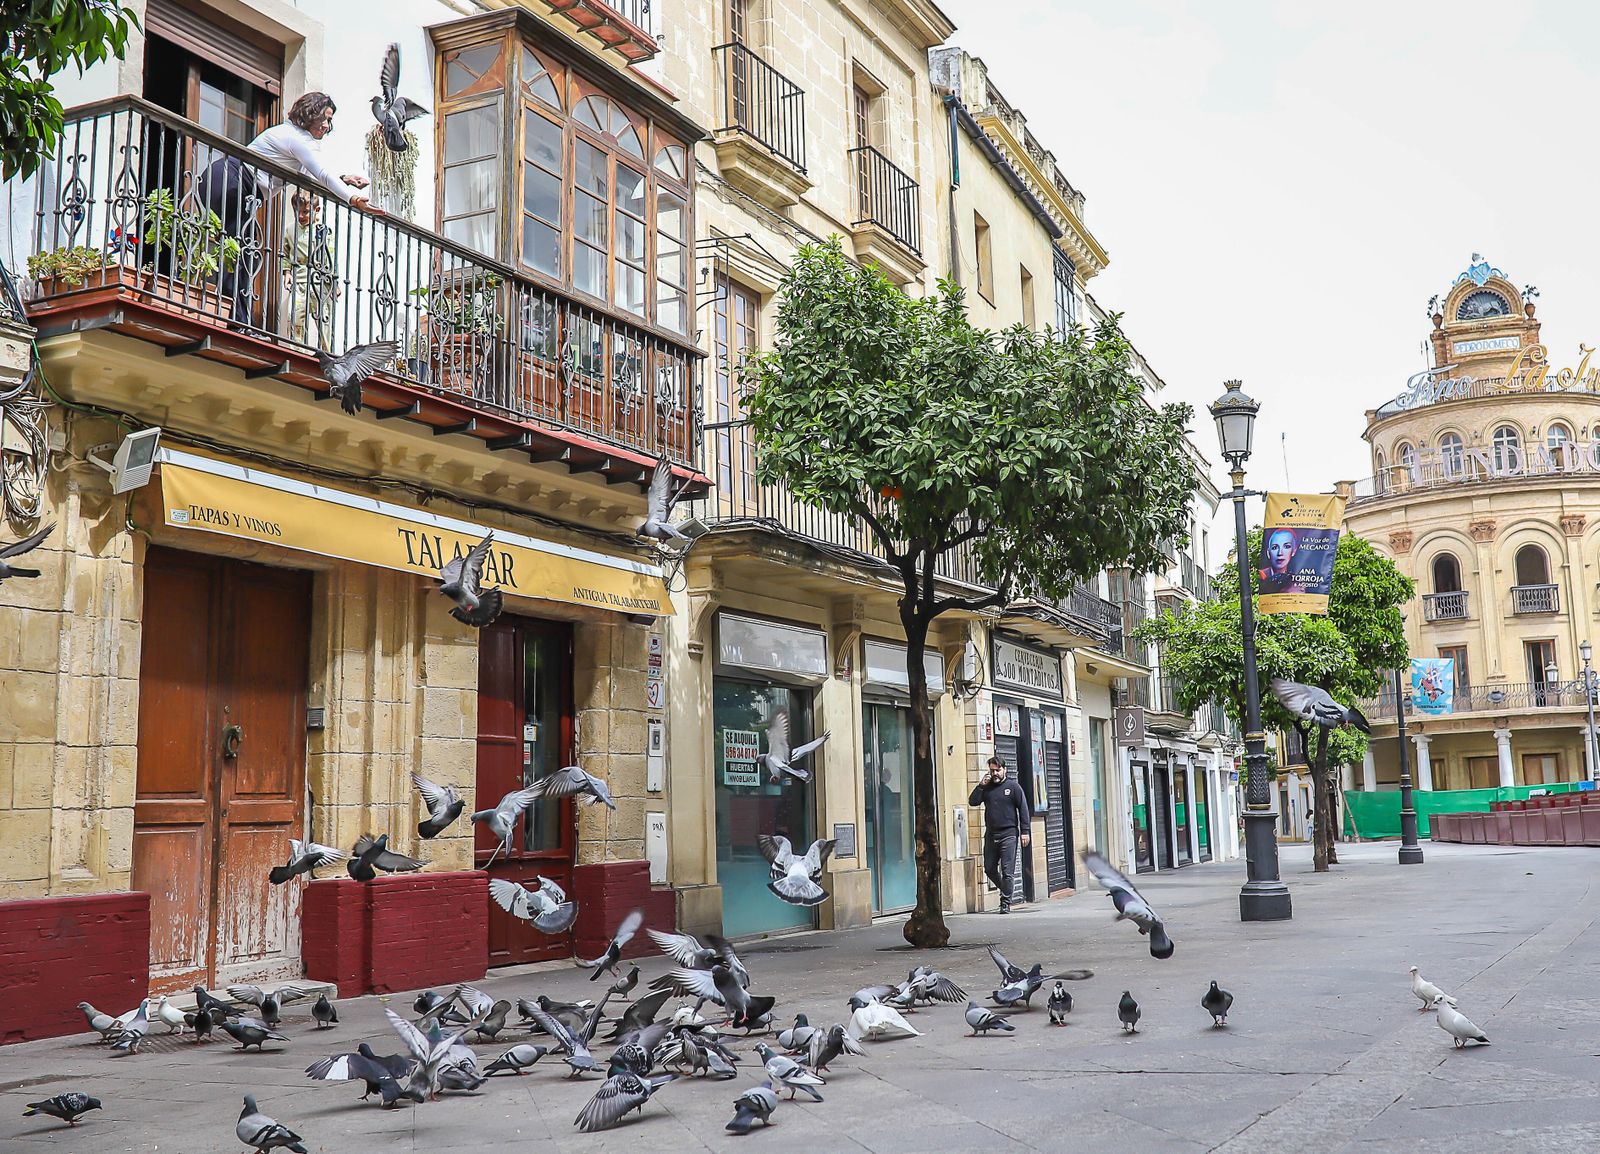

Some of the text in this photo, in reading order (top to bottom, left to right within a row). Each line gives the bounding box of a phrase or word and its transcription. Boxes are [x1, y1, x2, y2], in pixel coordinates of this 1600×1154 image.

[1396, 363, 1478, 408] Fino
[1484, 343, 1550, 393] La
[188, 504, 282, 537] TAPAS Y VINOS
[1291, 574, 1325, 583] TORROJA
[572, 586, 608, 604] ANTIGUA
[1004, 662, 1055, 689] 100 MONTADITOS
[726, 732, 757, 745] SE ALQUILA
[726, 747, 736, 758] 956
[737, 747, 743, 759] 34
[730, 763, 754, 771] HUERTAS
